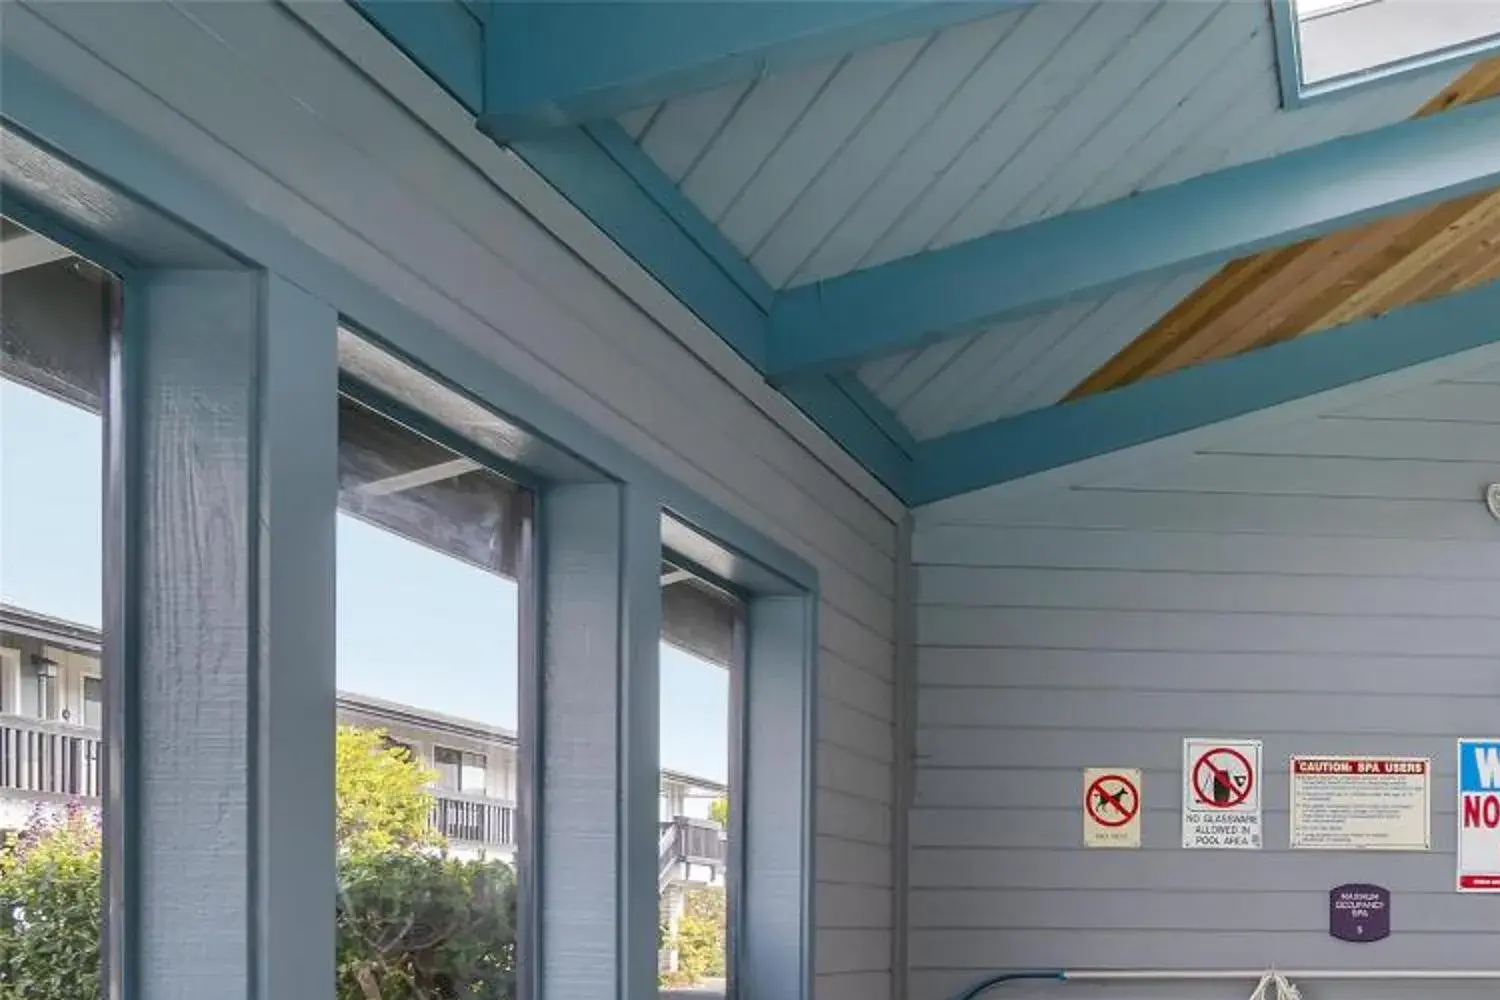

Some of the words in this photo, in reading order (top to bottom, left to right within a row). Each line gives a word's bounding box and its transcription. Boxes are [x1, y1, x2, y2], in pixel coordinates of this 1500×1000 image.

[1300, 762, 1352, 772] CAUTION:
[1357, 762, 1381, 772] SPA
[1385, 762, 1423, 773] USERS
[1464, 795, 1500, 828] NO
[1186, 814, 1200, 822] NO
[1195, 835, 1220, 844] POOL
